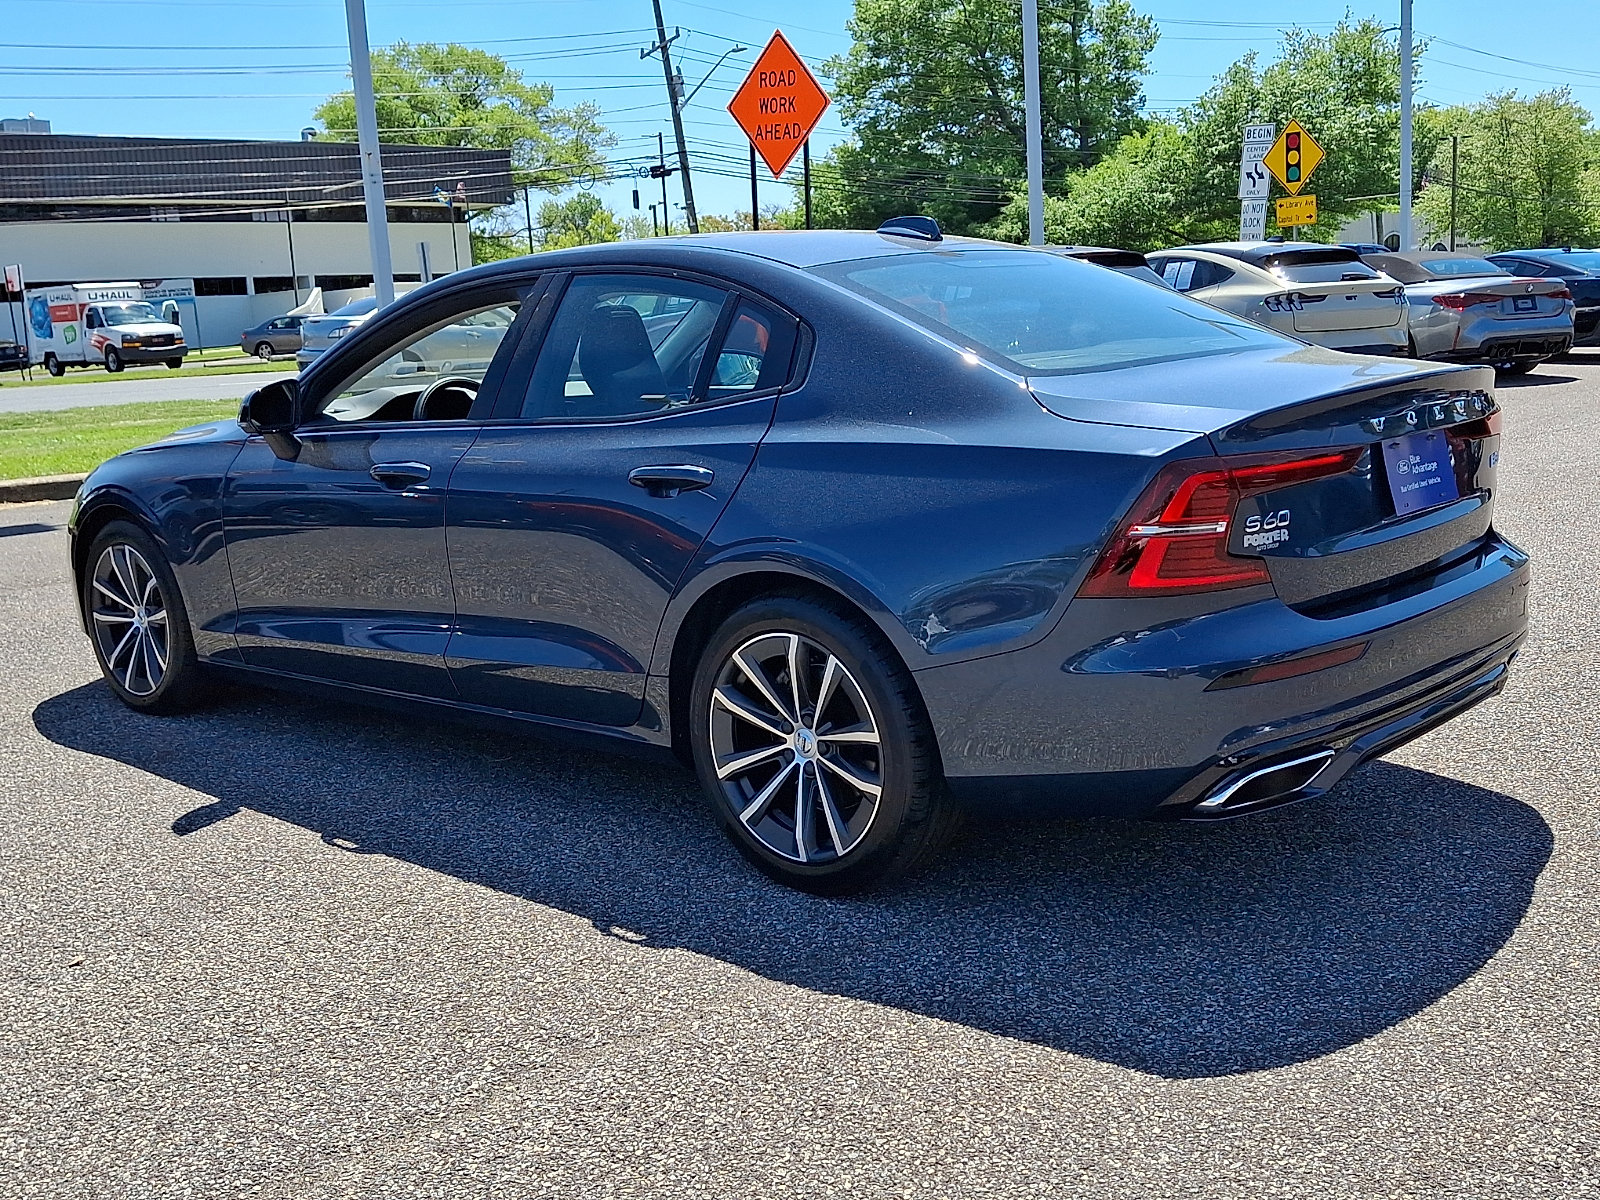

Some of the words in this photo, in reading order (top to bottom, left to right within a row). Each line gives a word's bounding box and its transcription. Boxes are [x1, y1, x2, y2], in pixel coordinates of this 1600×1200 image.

[759, 70, 796, 88] ROAD
[759, 96, 796, 114] WORK
[755, 123, 801, 140] AHEAD
[1246, 128, 1272, 139] BEGIN
[1243, 204, 1249, 214] DO
[1252, 203, 1264, 214] NOT
[1286, 201, 1302, 209] Library
[1242, 217, 1261, 228] BLOCK
[50, 293, 73, 302] U-HAUL
[87, 290, 133, 300] U-HAUL
[1370, 397, 1482, 432] VOLVO
[1409, 455, 1421, 464] Blue
[1412, 461, 1438, 474] Advantage
[1245, 510, 1290, 532] S60
[1243, 529, 1289, 548] PORTER
